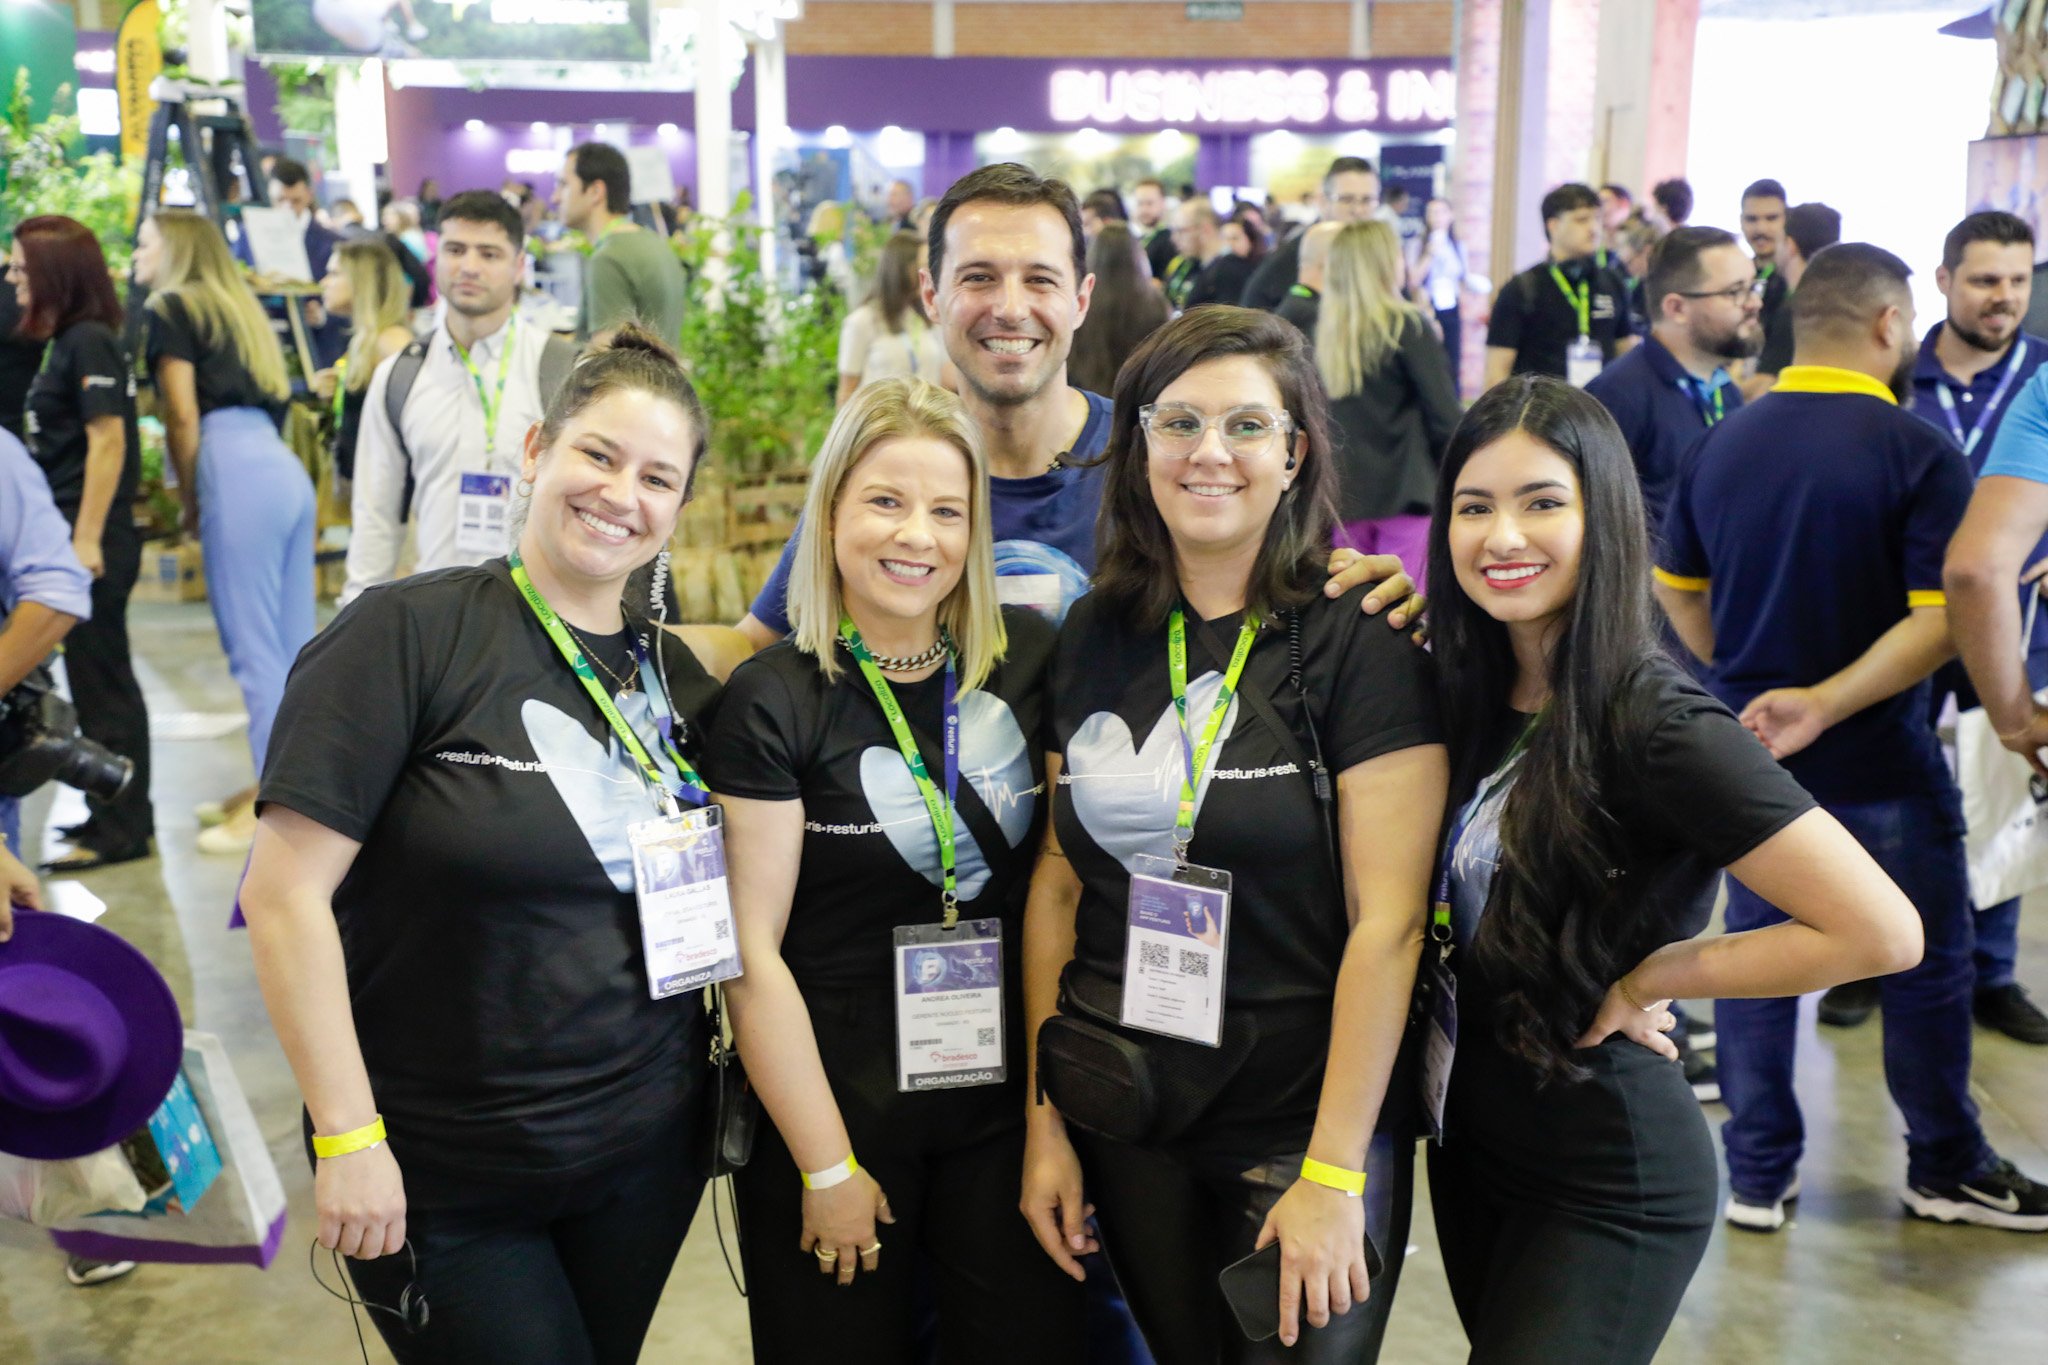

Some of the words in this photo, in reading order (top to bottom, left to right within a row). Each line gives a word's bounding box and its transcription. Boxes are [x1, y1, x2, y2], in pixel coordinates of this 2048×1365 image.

[1050, 69, 1330, 122] BUSINESS
[1333, 69, 1379, 122] &
[1386, 69, 1458, 122] IN
[524, 583, 552, 621] Localiza
[1173, 628, 1183, 664] Localiza
[1231, 629, 1253, 668] Localiza
[874, 679, 898, 716] Localiza
[599, 697, 629, 736] Localiza
[1210, 766, 1266, 781] Festuris
[826, 821, 883, 835] Festuris
[929, 799, 948, 839] Localiza
[664, 971, 713, 991] ORGANIZA
[941, 1051, 978, 1063] bradesco
[915, 1071, 993, 1087] ORGANIZAÇÃO
